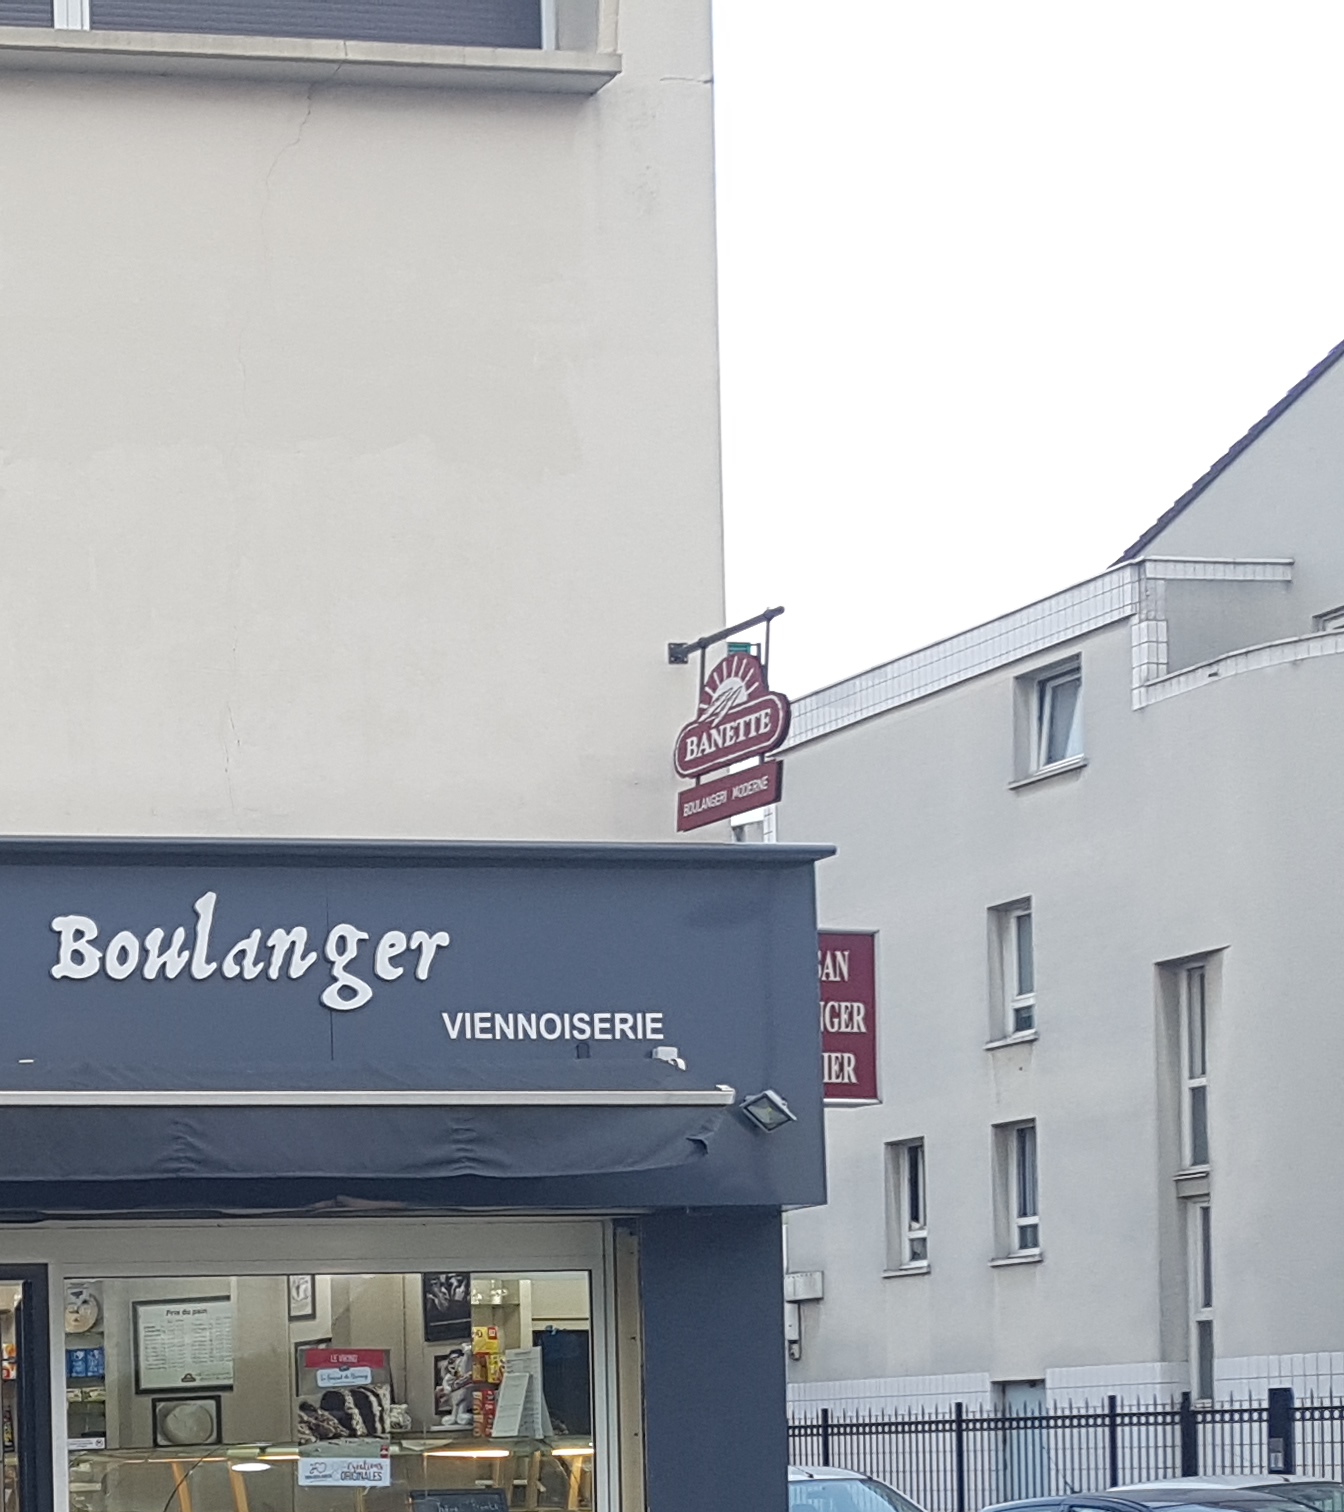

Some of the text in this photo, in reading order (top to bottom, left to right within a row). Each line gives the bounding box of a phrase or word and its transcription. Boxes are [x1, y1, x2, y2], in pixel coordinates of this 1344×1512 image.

[685, 709, 771, 761] BANETTE
[732, 775, 769, 800] MODERNE
[50, 891, 451, 1010] Boulanger
[442, 1012, 665, 1042] VIENNOISERIE
